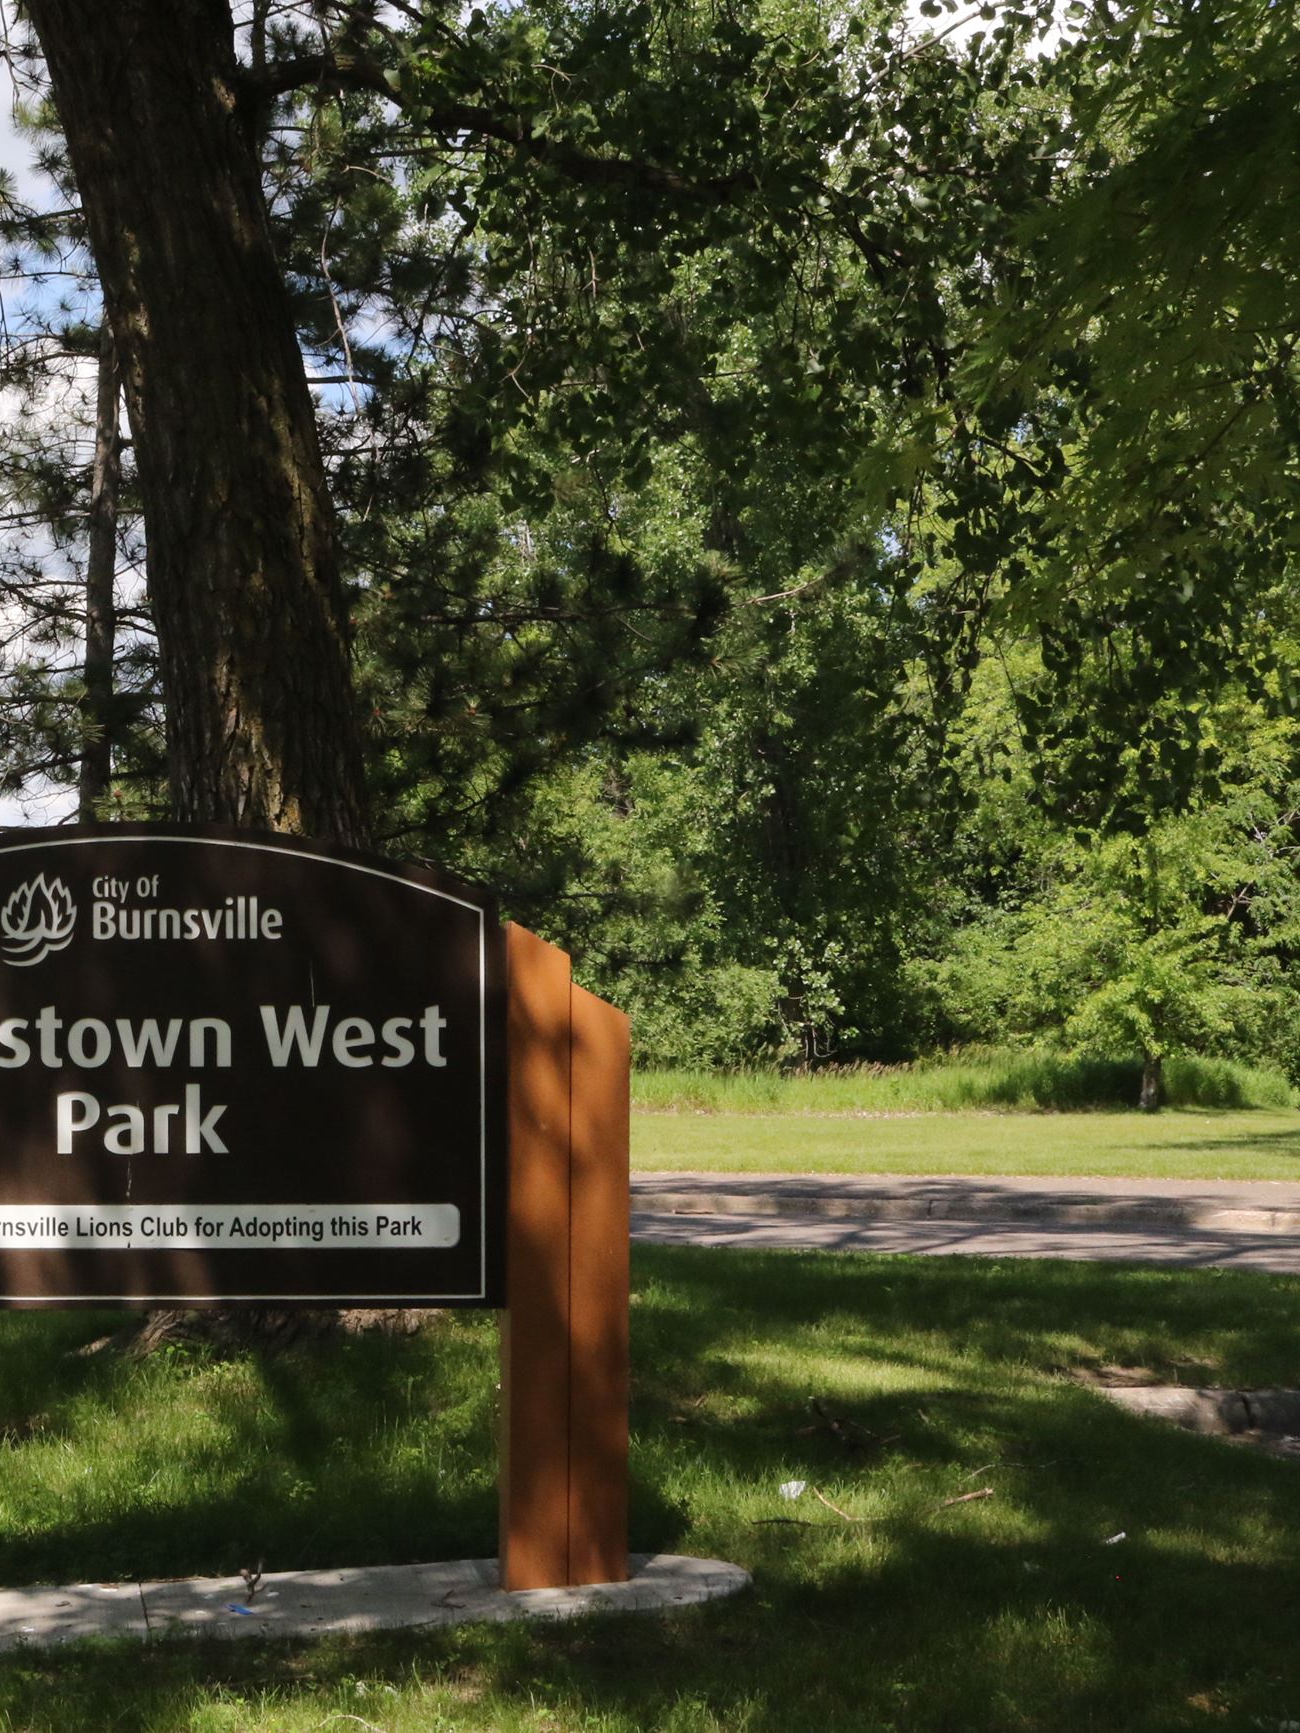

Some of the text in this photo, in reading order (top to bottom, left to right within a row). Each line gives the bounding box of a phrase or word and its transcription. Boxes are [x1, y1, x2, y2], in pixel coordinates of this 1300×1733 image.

[92, 874, 160, 901] City Of
[92, 897, 283, 941] Burnsville
[259, 1005, 448, 1068] West
[56, 1084, 229, 1155] Park
[76, 1216, 133, 1238] Lions
[139, 1216, 188, 1238] Club
[193, 1216, 223, 1238] for
[229, 1216, 324, 1242] Adopting
[330, 1216, 369, 1238] this
[375, 1216, 423, 1238] Park
